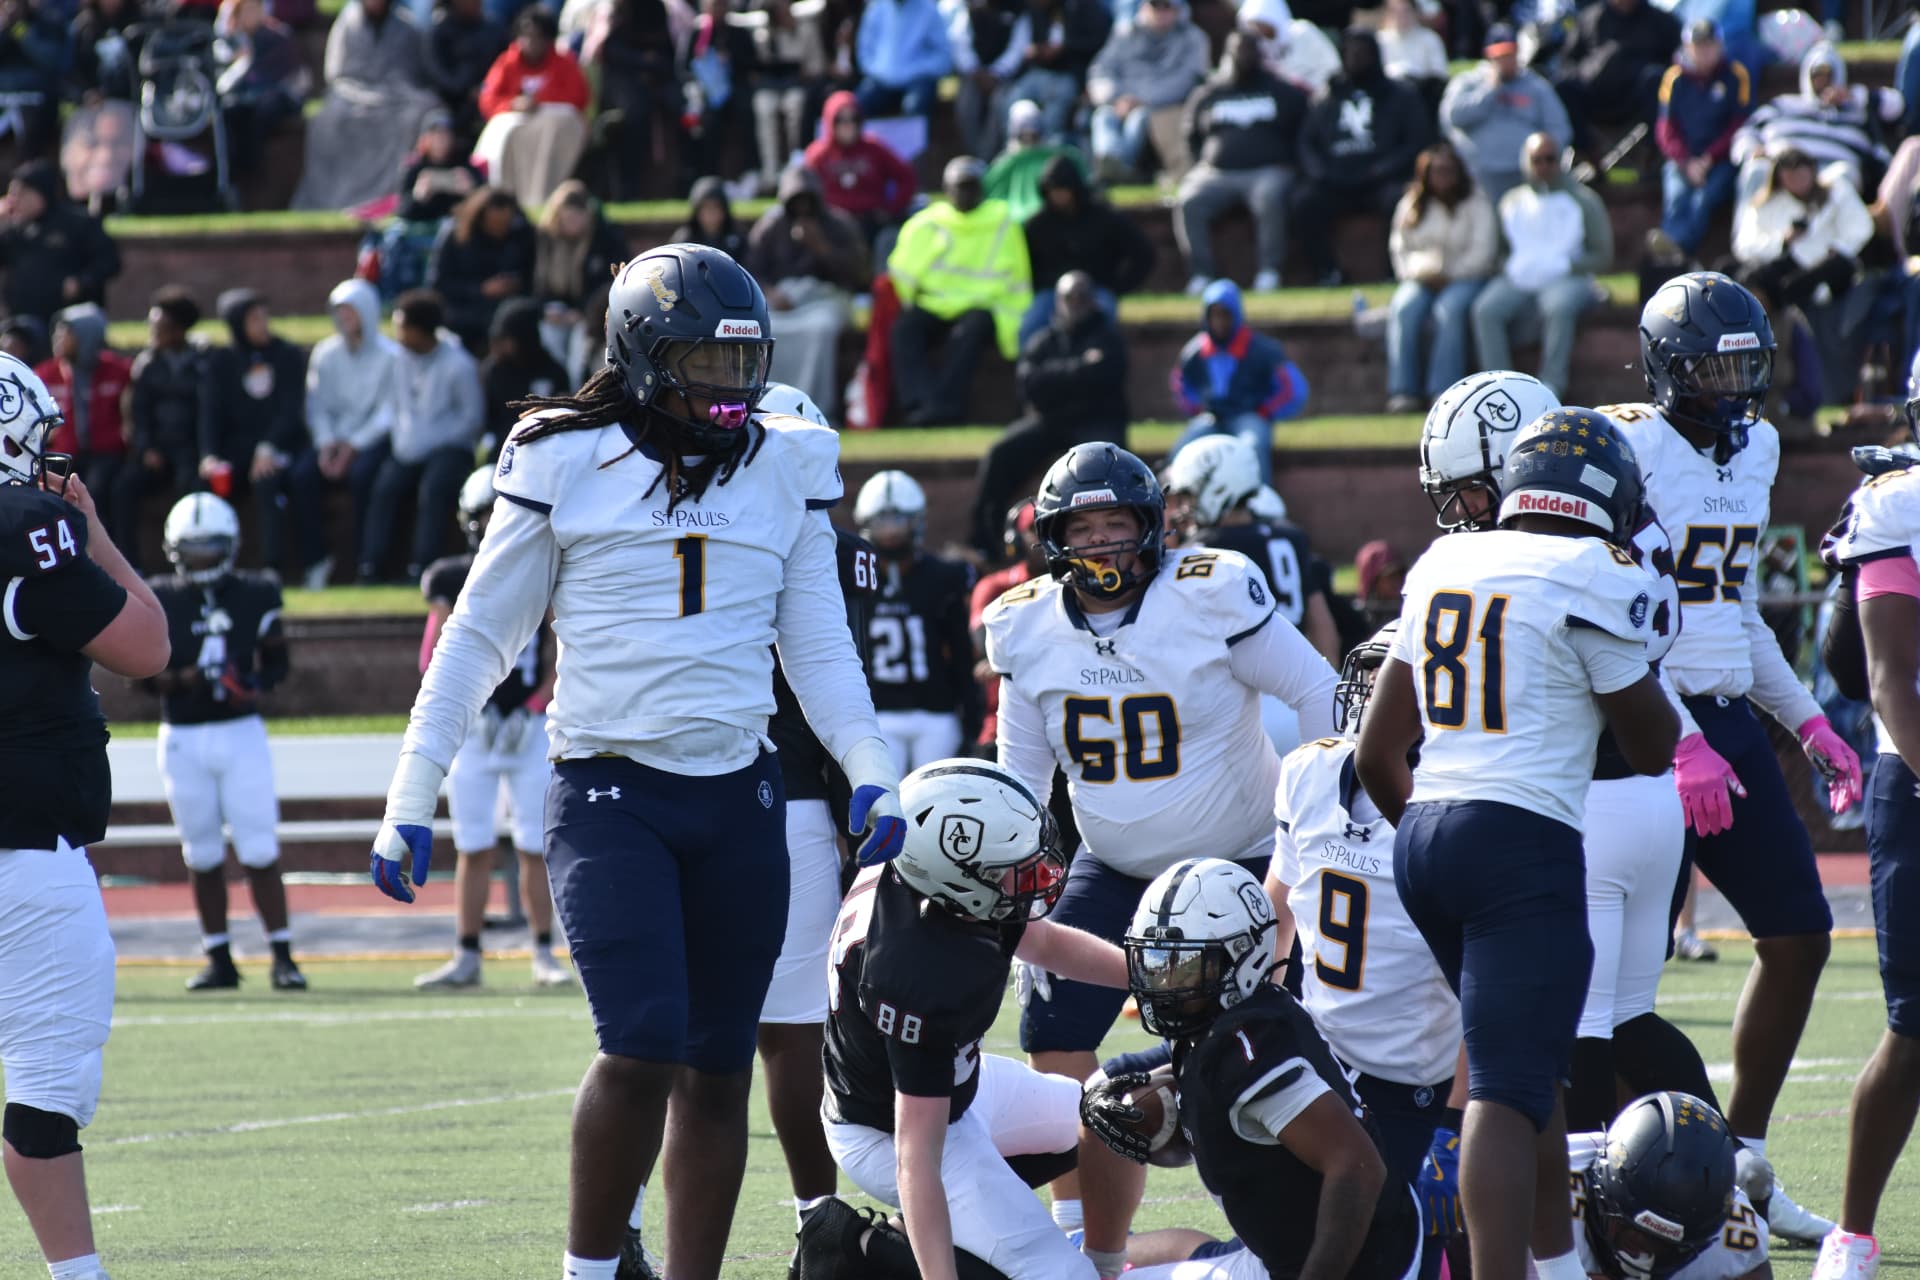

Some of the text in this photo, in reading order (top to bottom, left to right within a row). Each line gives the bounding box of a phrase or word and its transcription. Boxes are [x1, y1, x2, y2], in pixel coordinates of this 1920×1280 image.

[723, 324, 760, 336] Riddell
[1723, 336, 1758, 348] Riddell
[1486, 401, 1516, 423] AC
[1075, 492, 1113, 507] Riddell
[1518, 494, 1588, 519] Riddell
[28, 518, 77, 571] 54
[1674, 523, 1760, 606] 55
[672, 532, 709, 619] 1
[854, 550, 879, 592] 66
[868, 614, 930, 684] 21
[1423, 588, 1512, 735] 81
[1062, 691, 1183, 786] 60
[947, 821, 971, 856] AC
[1246, 888, 1268, 919] AC
[1313, 867, 1371, 993] 9
[875, 1001, 923, 1046] 88
[1235, 1028, 1256, 1063] 1
